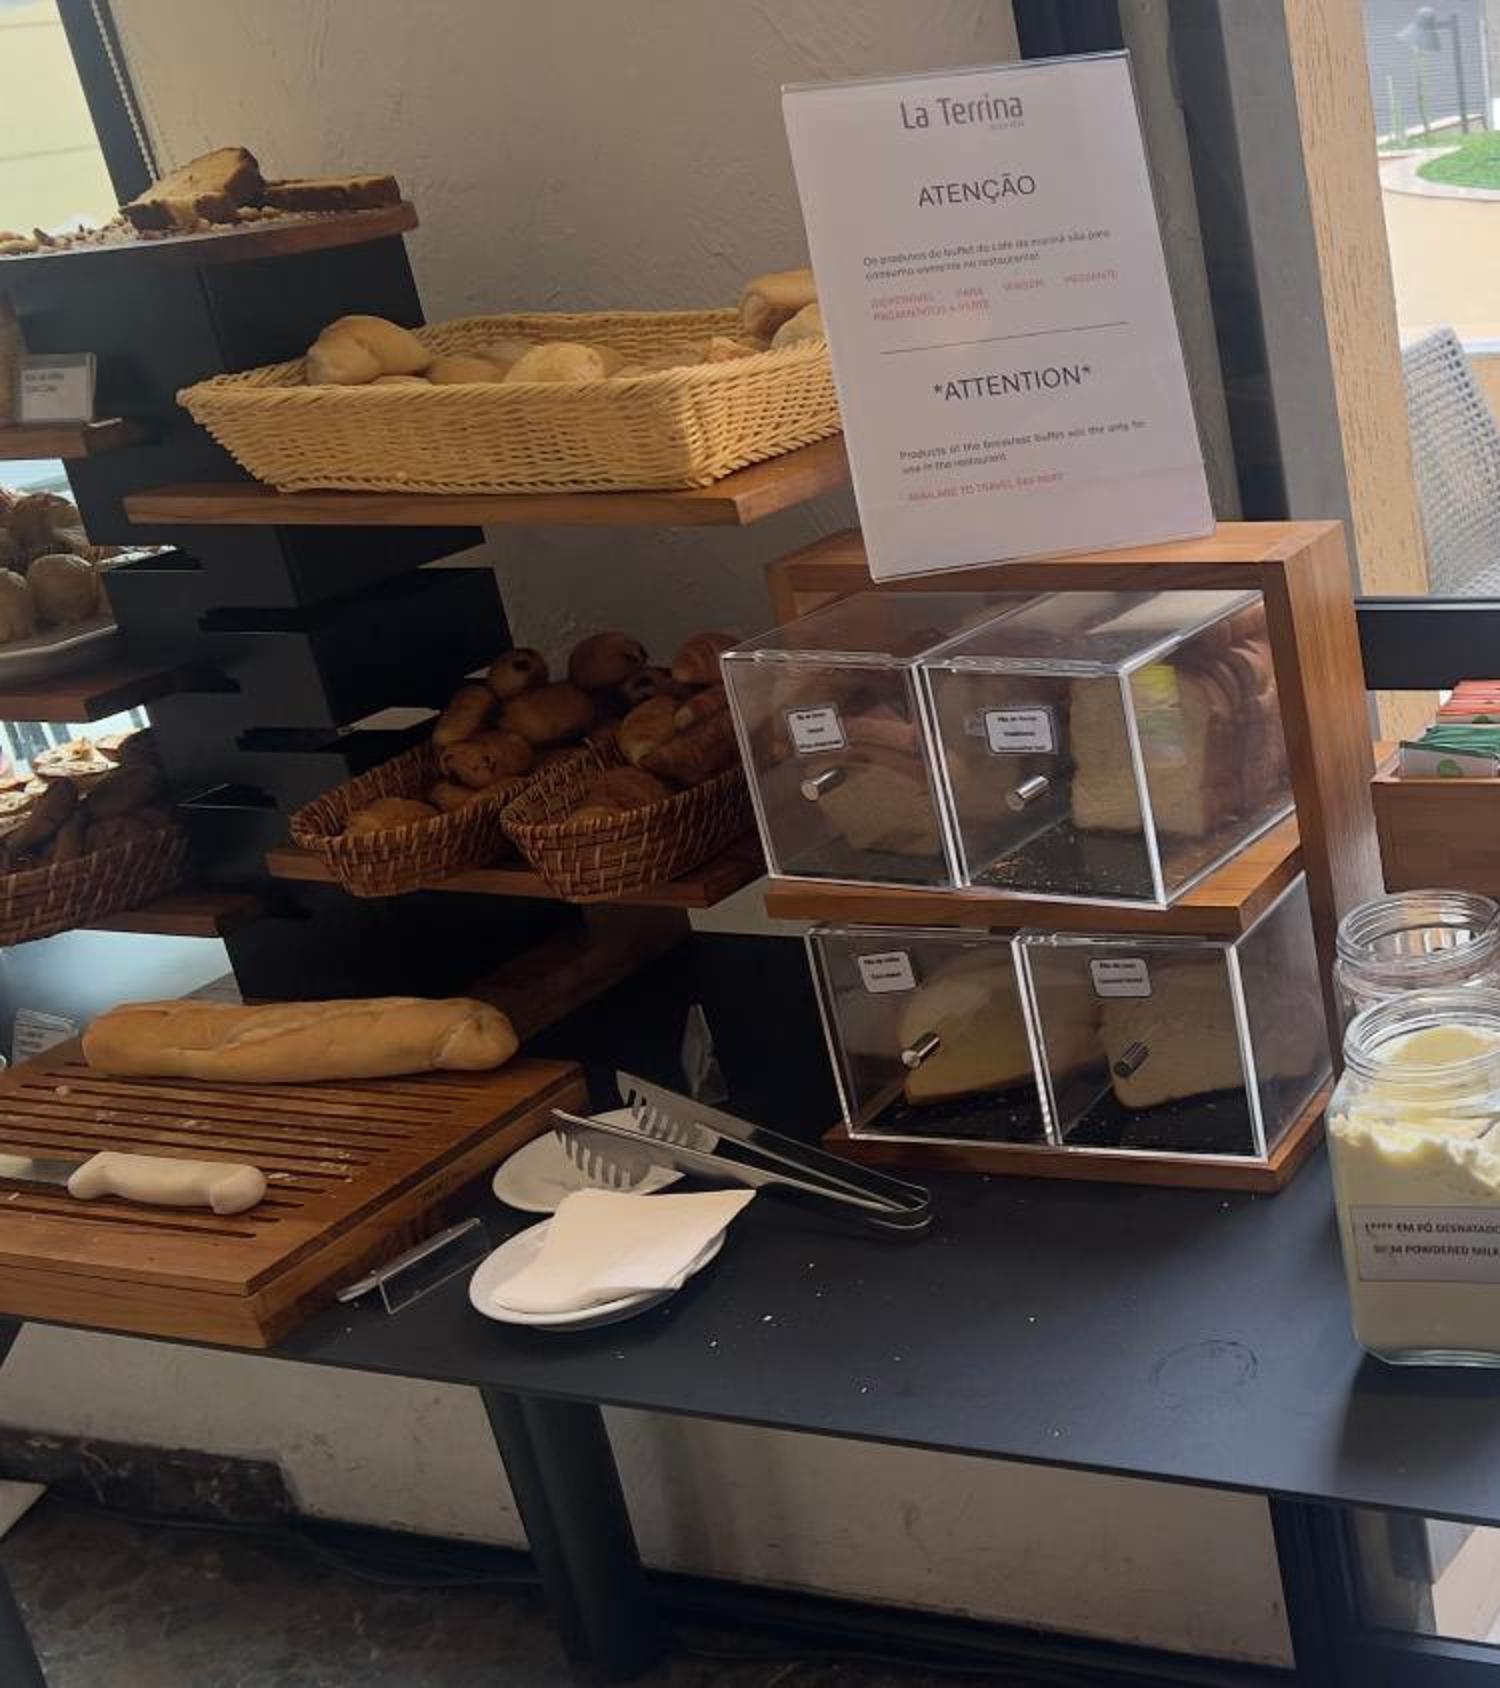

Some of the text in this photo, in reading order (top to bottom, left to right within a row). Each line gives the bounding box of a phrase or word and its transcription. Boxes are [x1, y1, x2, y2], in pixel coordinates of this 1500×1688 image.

[899, 92, 1024, 129] La Terrina
[918, 172, 1037, 207] ATENÇÃO
[1416, 1221, 1433, 1234] PÓ
[1404, 1245, 1470, 1257] POWDERED
[1472, 1246, 1500, 1257] MILK
